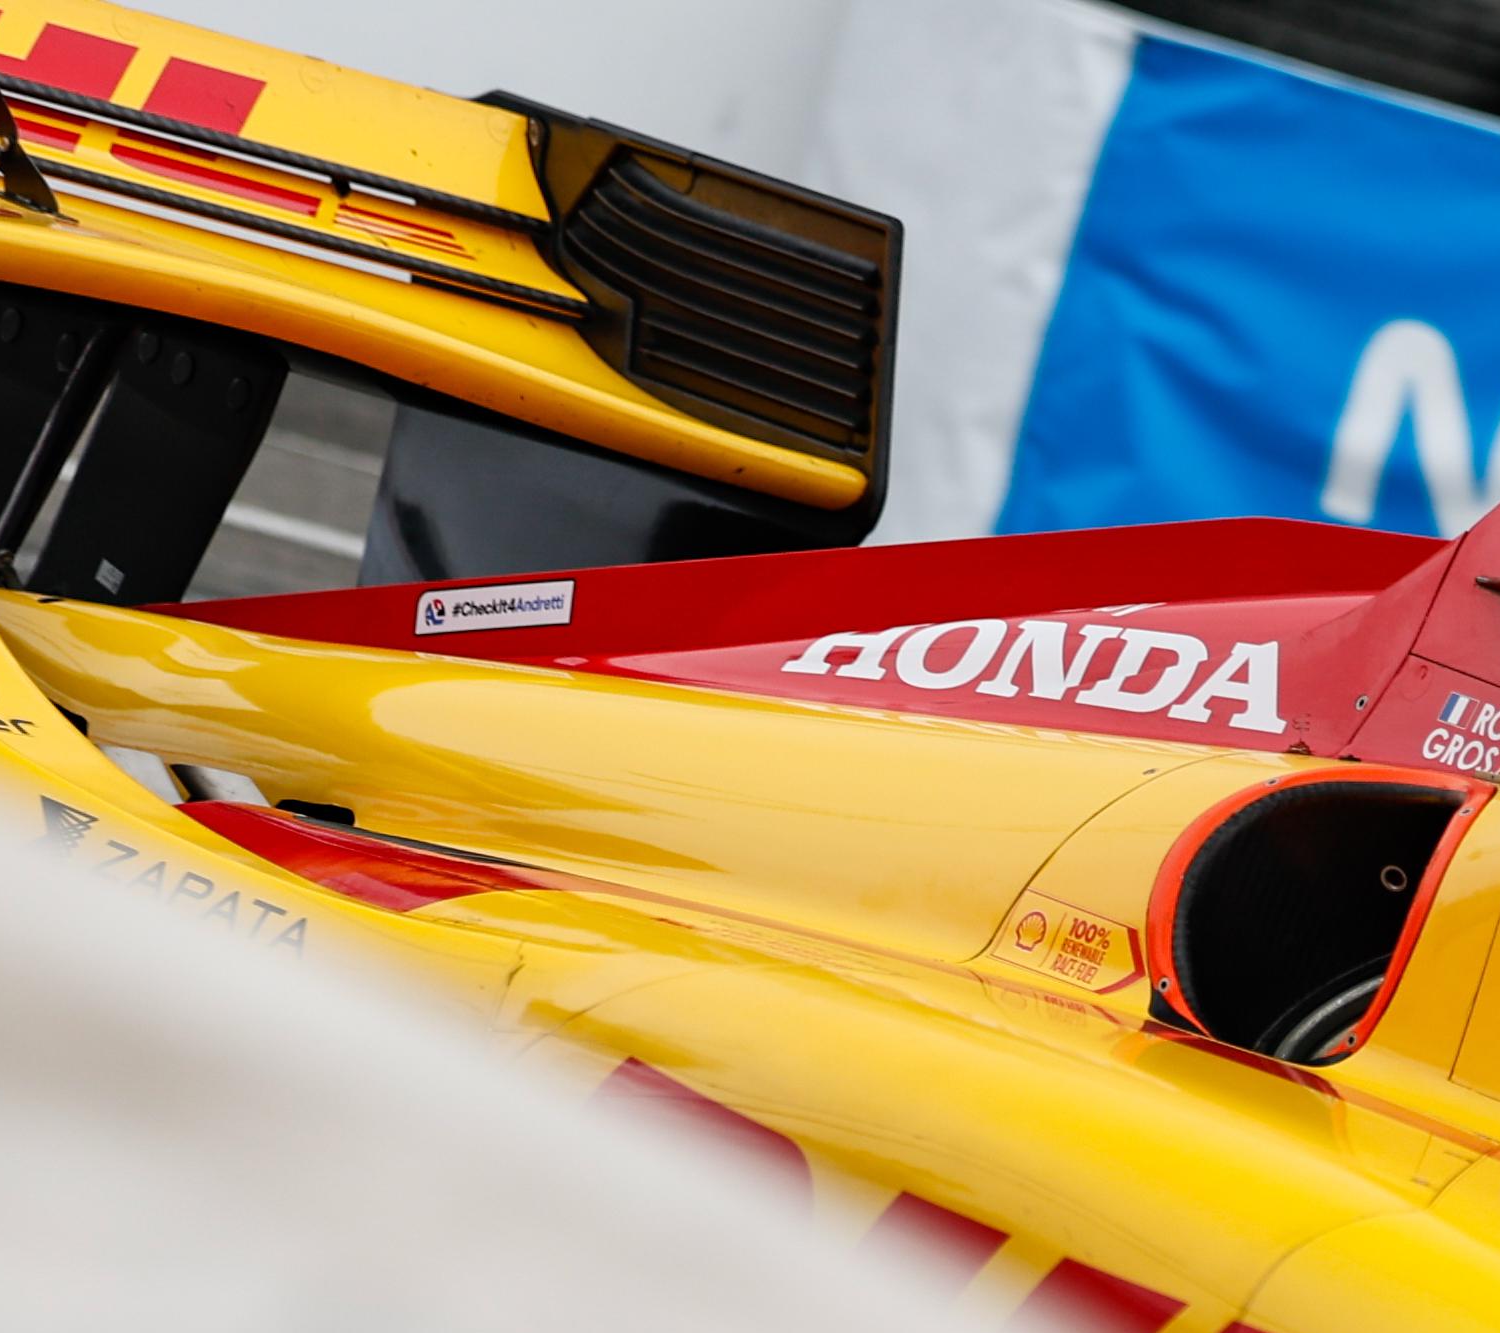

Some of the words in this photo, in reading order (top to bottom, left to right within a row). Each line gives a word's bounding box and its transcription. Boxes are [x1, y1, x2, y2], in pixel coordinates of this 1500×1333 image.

[781, 618, 1286, 734] HONDA
[95, 839, 308, 959] ZAPATA
[1069, 917, 1112, 950] 100%
